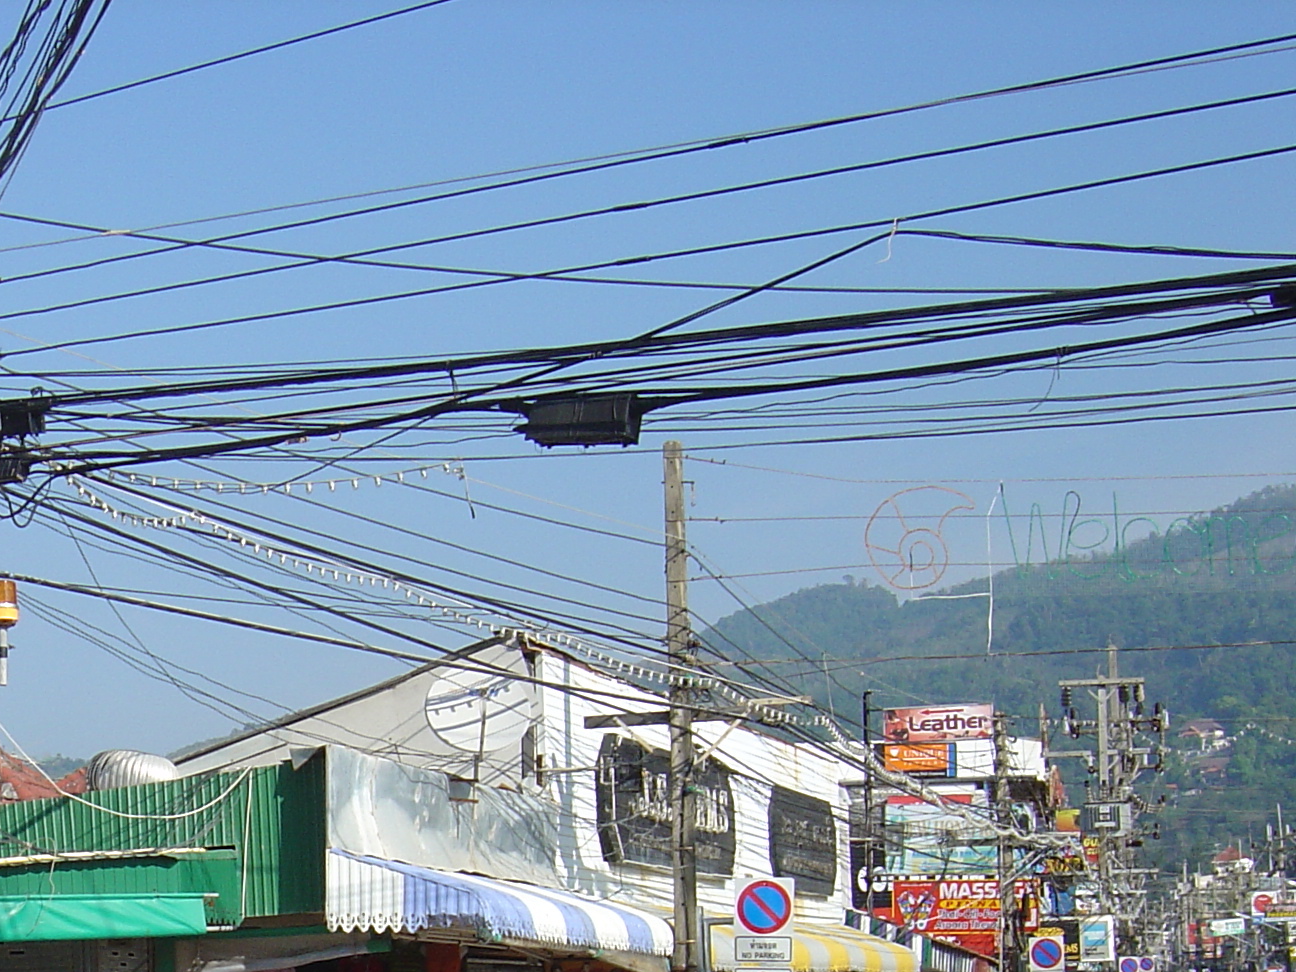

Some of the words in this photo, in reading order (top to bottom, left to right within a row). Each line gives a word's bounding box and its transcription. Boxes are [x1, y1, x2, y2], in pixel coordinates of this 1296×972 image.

[908, 714, 988, 732] Leather
[741, 951, 752, 959] NO
[754, 951, 785, 960] PARKING
